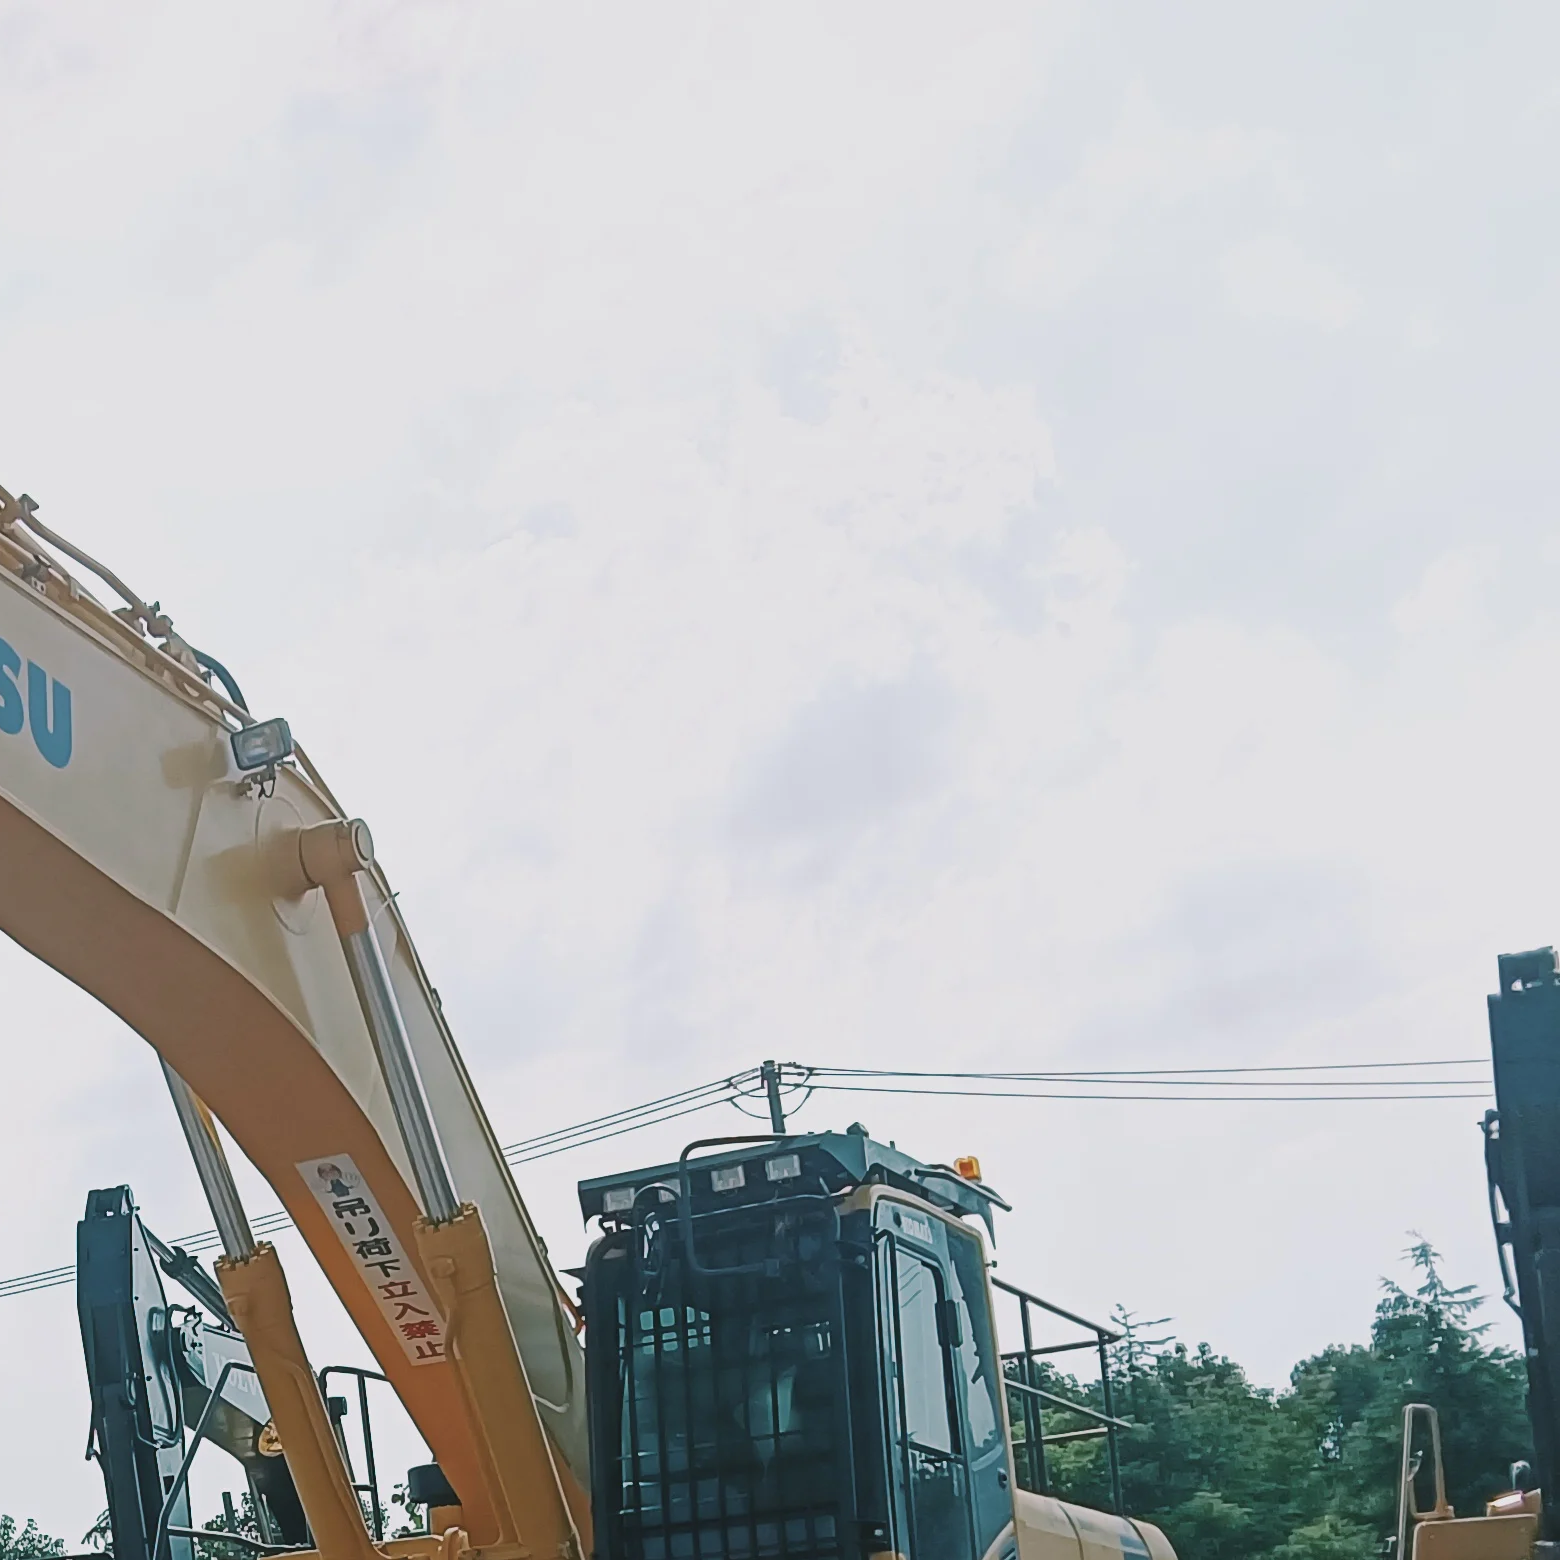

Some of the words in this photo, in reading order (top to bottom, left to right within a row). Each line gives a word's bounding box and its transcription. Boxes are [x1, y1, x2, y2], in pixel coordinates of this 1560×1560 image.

[332, 1196, 447, 1360] 吊り荷下立入禁止
